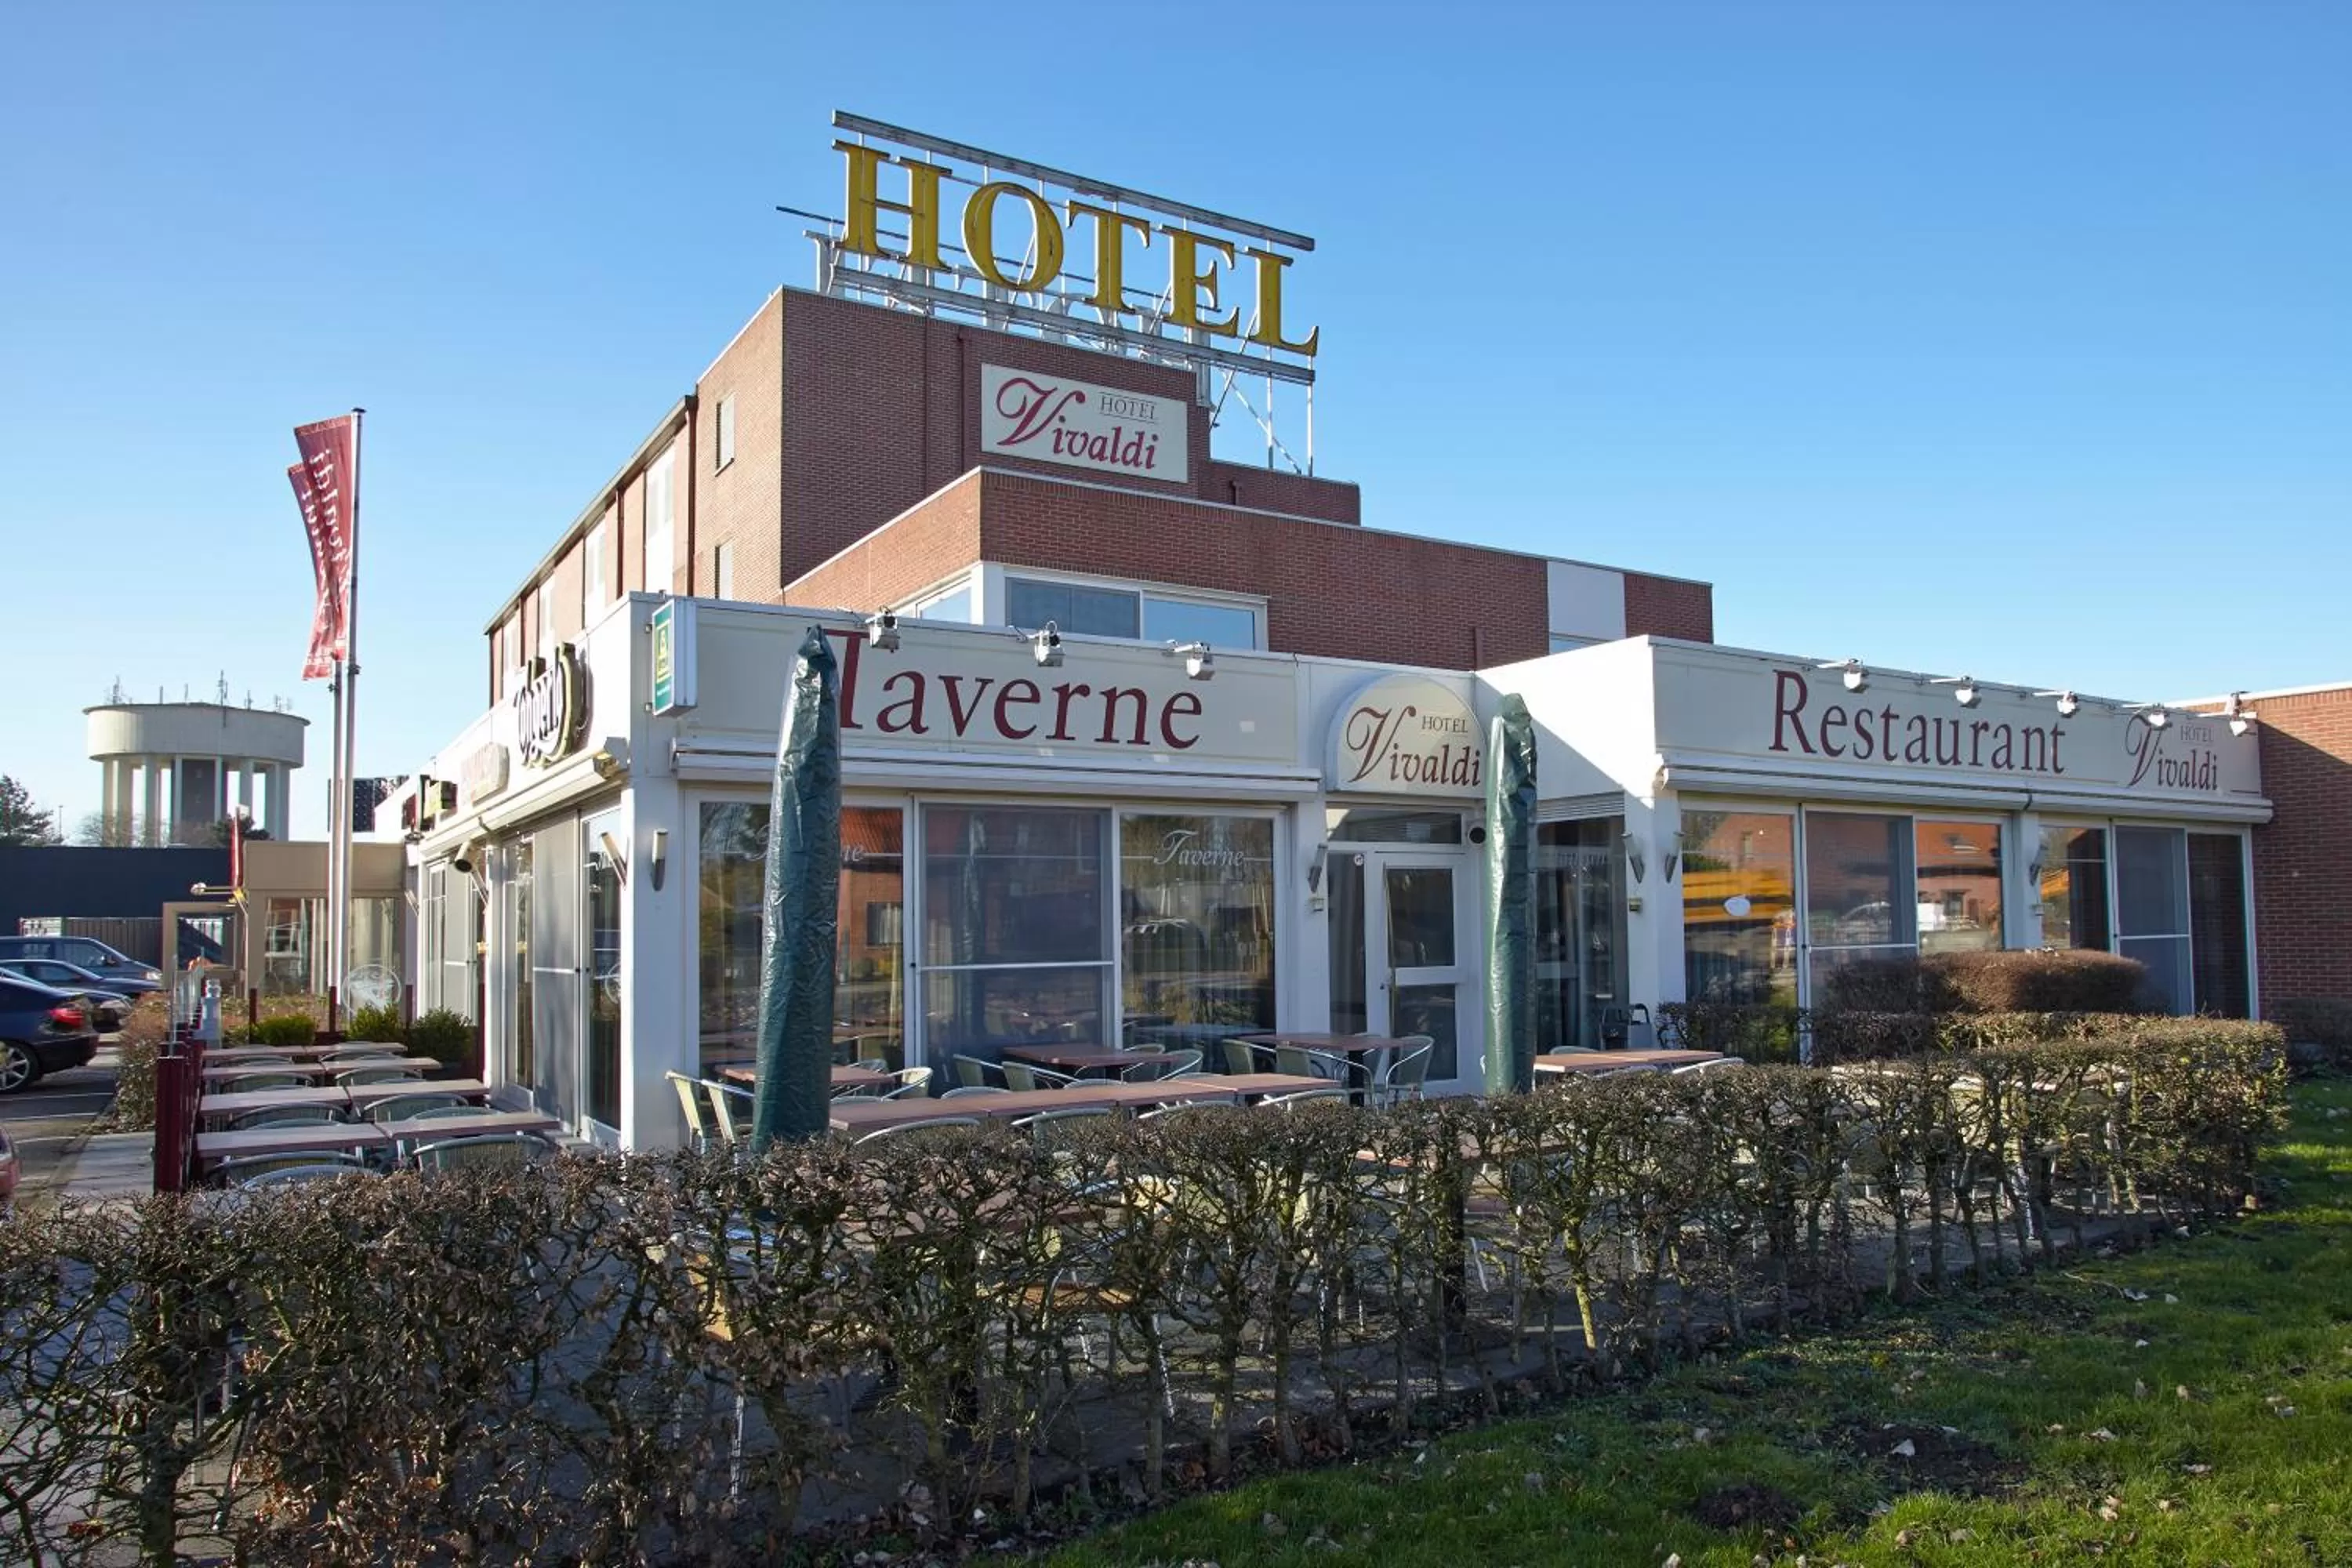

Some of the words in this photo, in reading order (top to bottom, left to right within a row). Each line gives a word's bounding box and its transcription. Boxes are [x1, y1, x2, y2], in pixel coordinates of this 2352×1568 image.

[831, 137, 1319, 357] HOTEL
[996, 377, 1159, 470] Vivaldi
[1099, 394, 1157, 420] HOTEL
[823, 628, 1203, 750] Taverne
[1421, 714, 1468, 734] HOTEL
[1768, 668, 2066, 775] Restaurant
[1345, 706, 1482, 786] Vivaldi
[2125, 713, 2218, 791] Vivaldi
[2180, 724, 2215, 743] HOTEL
[1153, 829, 1244, 866] Taverne
